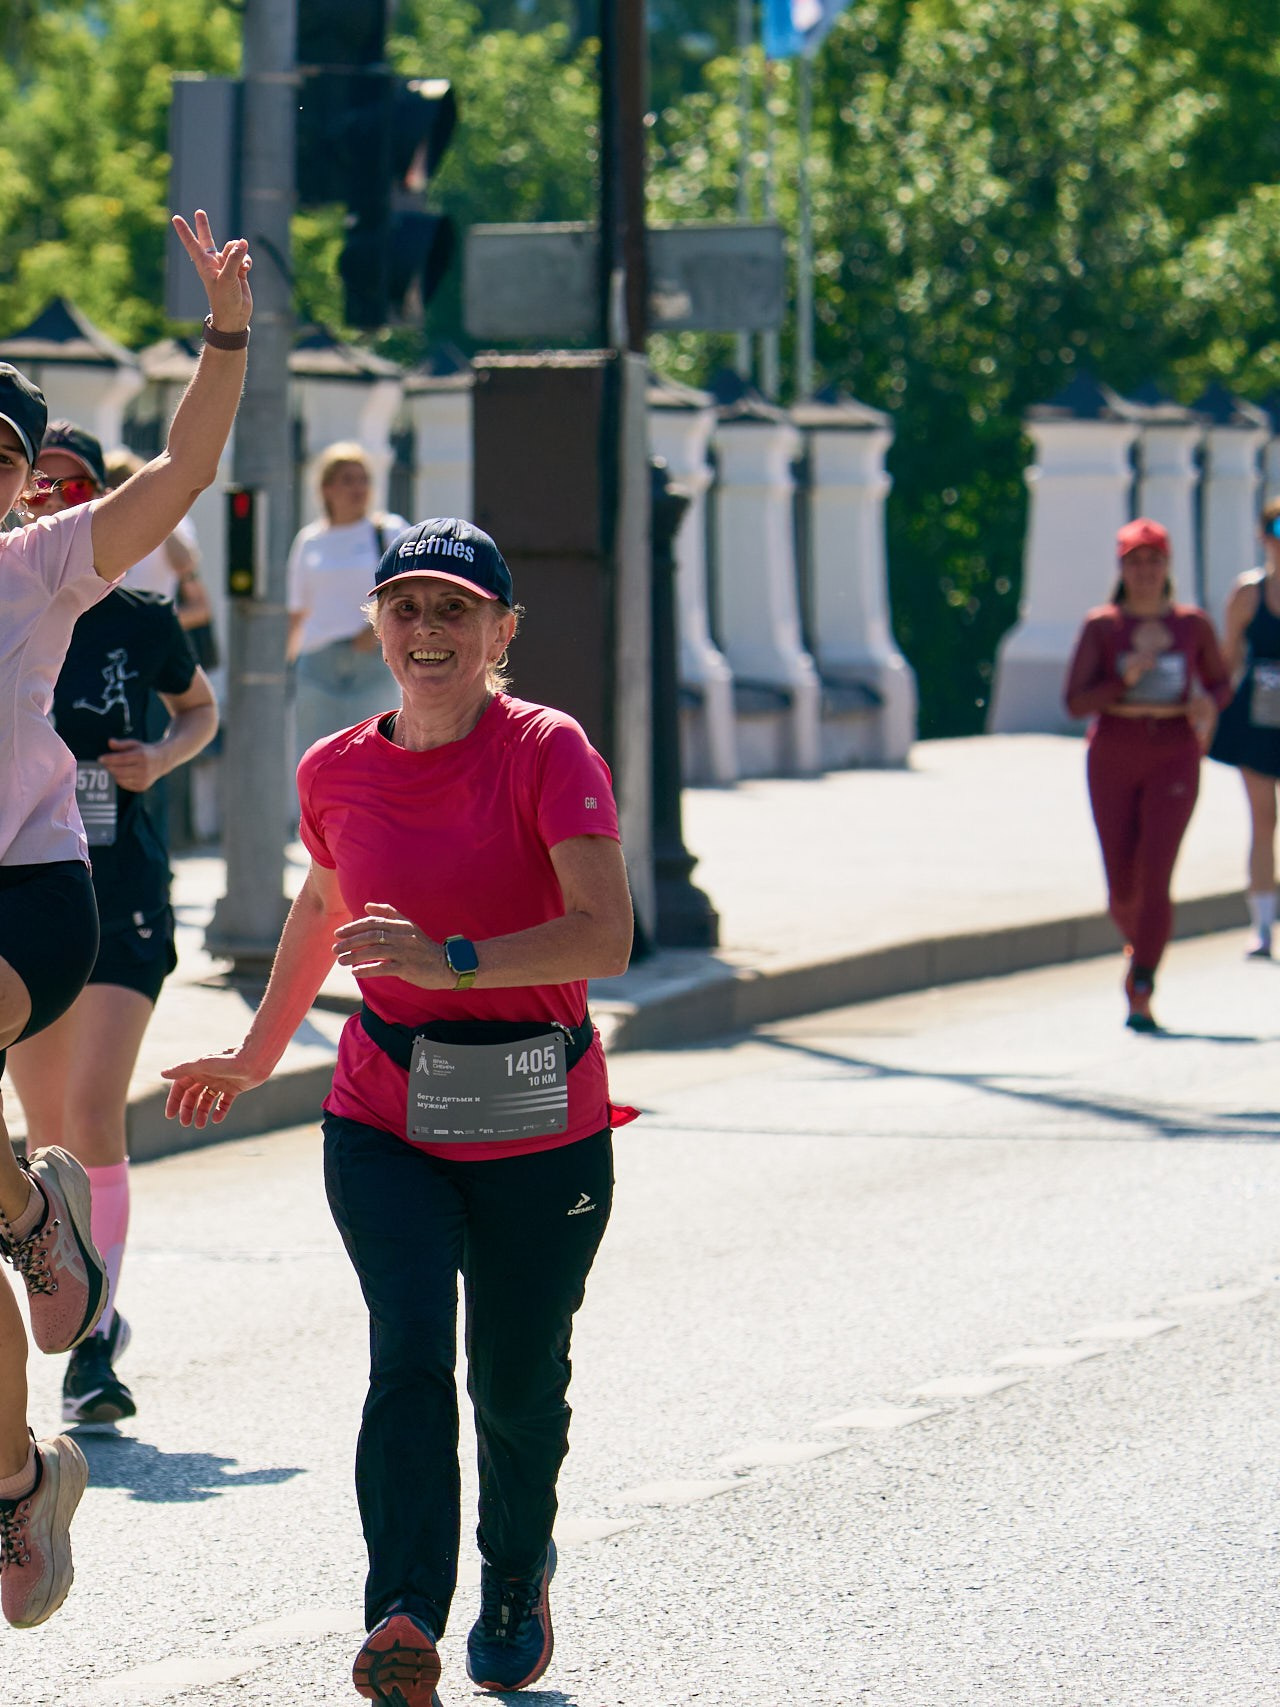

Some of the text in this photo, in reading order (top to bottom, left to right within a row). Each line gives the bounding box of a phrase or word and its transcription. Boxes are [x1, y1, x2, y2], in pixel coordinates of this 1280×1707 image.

[505, 1045, 556, 1077] 1405
[528, 1076, 540, 1087] 10
[417, 1092, 435, 1102] бегу
[417, 1102, 449, 1110] мужем!
[567, 1203, 597, 1216] DEMIX
